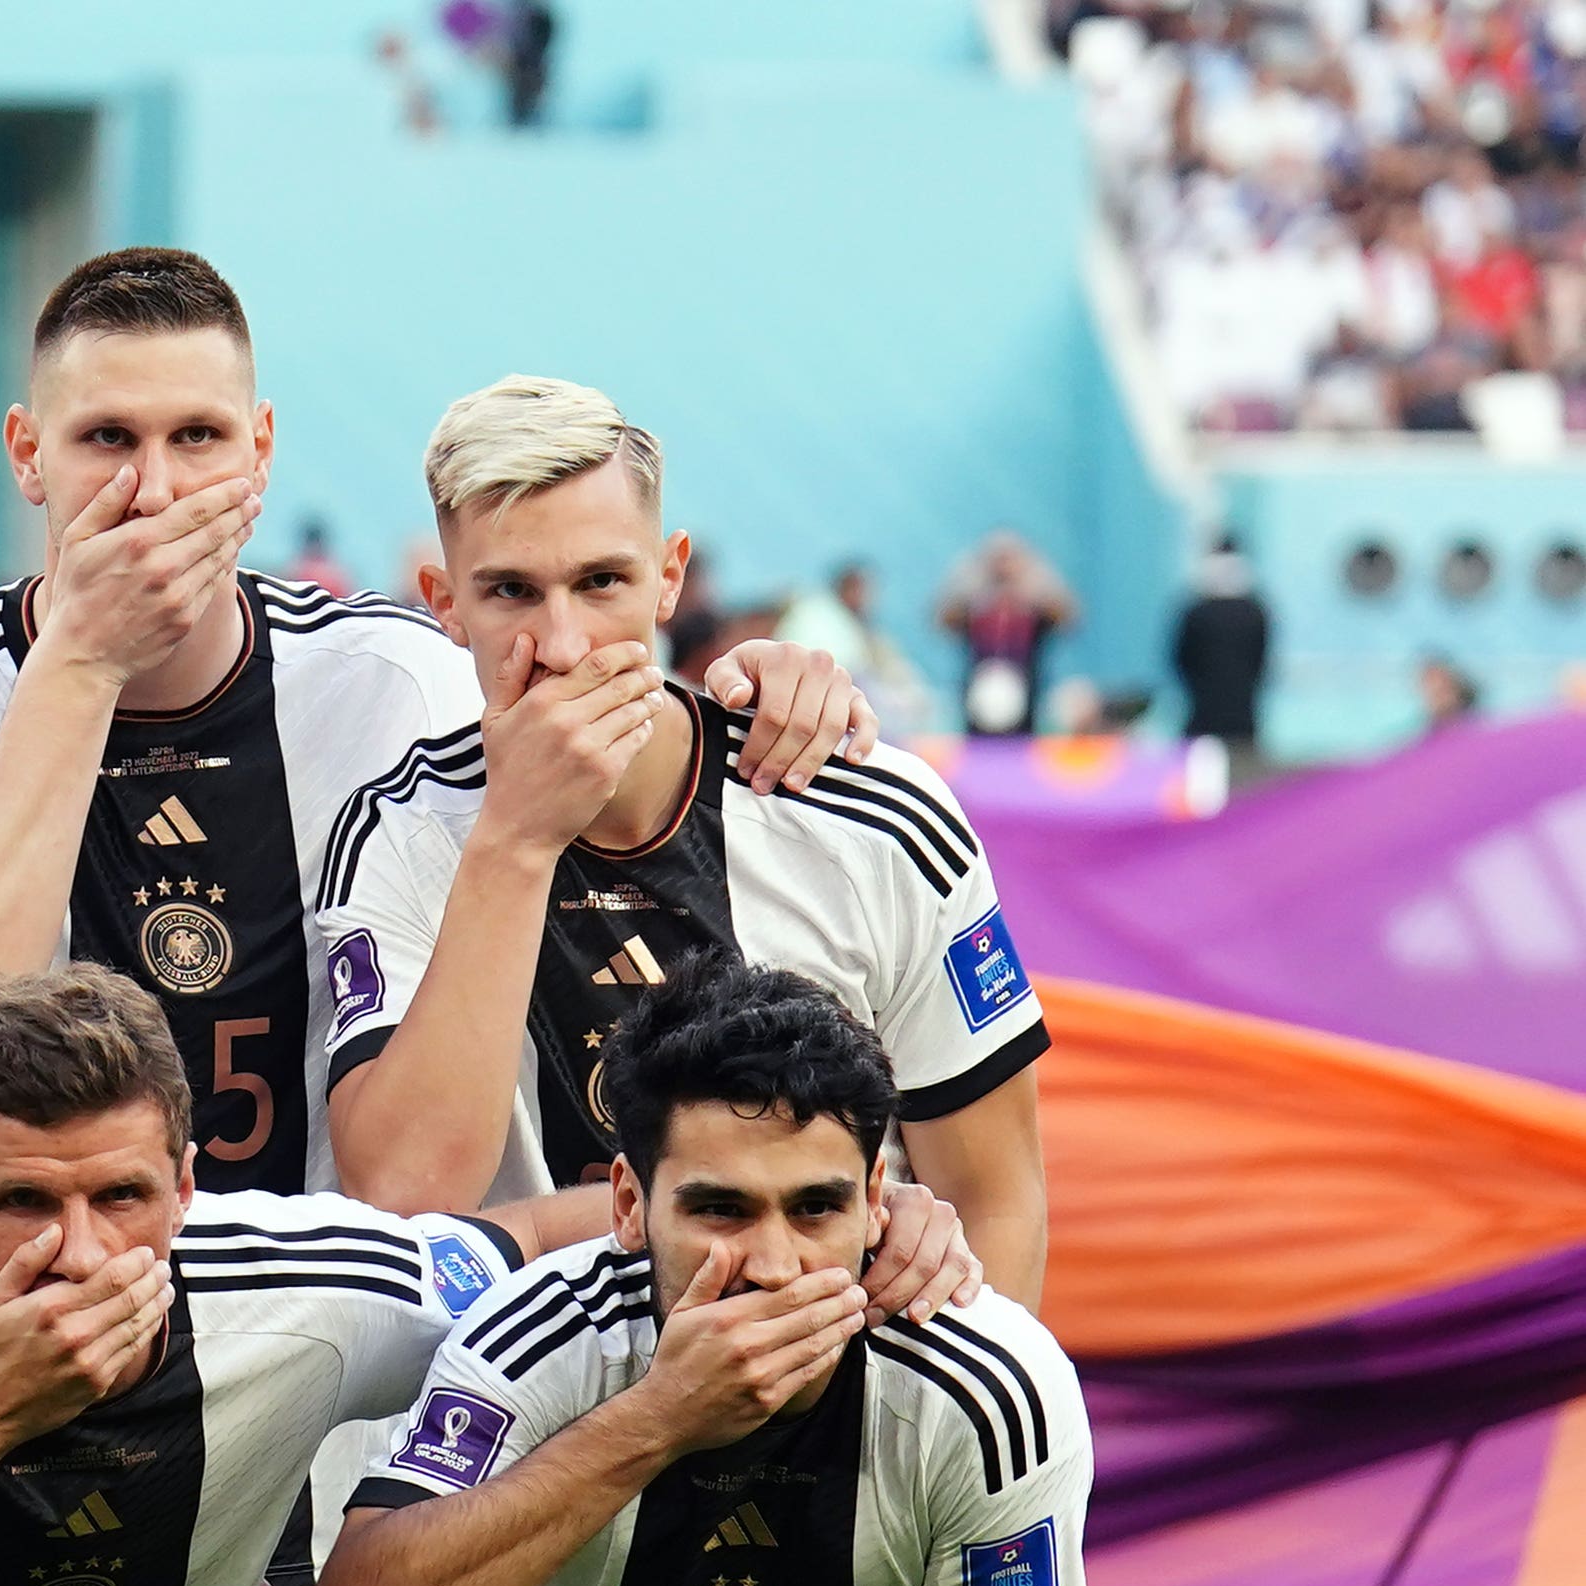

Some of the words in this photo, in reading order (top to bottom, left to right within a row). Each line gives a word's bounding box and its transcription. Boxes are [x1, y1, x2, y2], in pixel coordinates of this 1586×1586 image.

[135, 754, 178, 766] NOVEMBER
[179, 750, 199, 762] 2022
[156, 914, 208, 934] DEUTSCHER
[974, 948, 1005, 977] FOOTBALL
[978, 957, 1009, 989] UNITES
[981, 985, 996, 1002] the
[990, 969, 1017, 994] World
[994, 992, 1012, 1004] FIFA
[204, 1017, 275, 1162] 5
[430, 1446, 458, 1460] WORLD
[458, 1456, 474, 1466] CUP
[990, 1562, 1032, 1582] FOOTBALL
